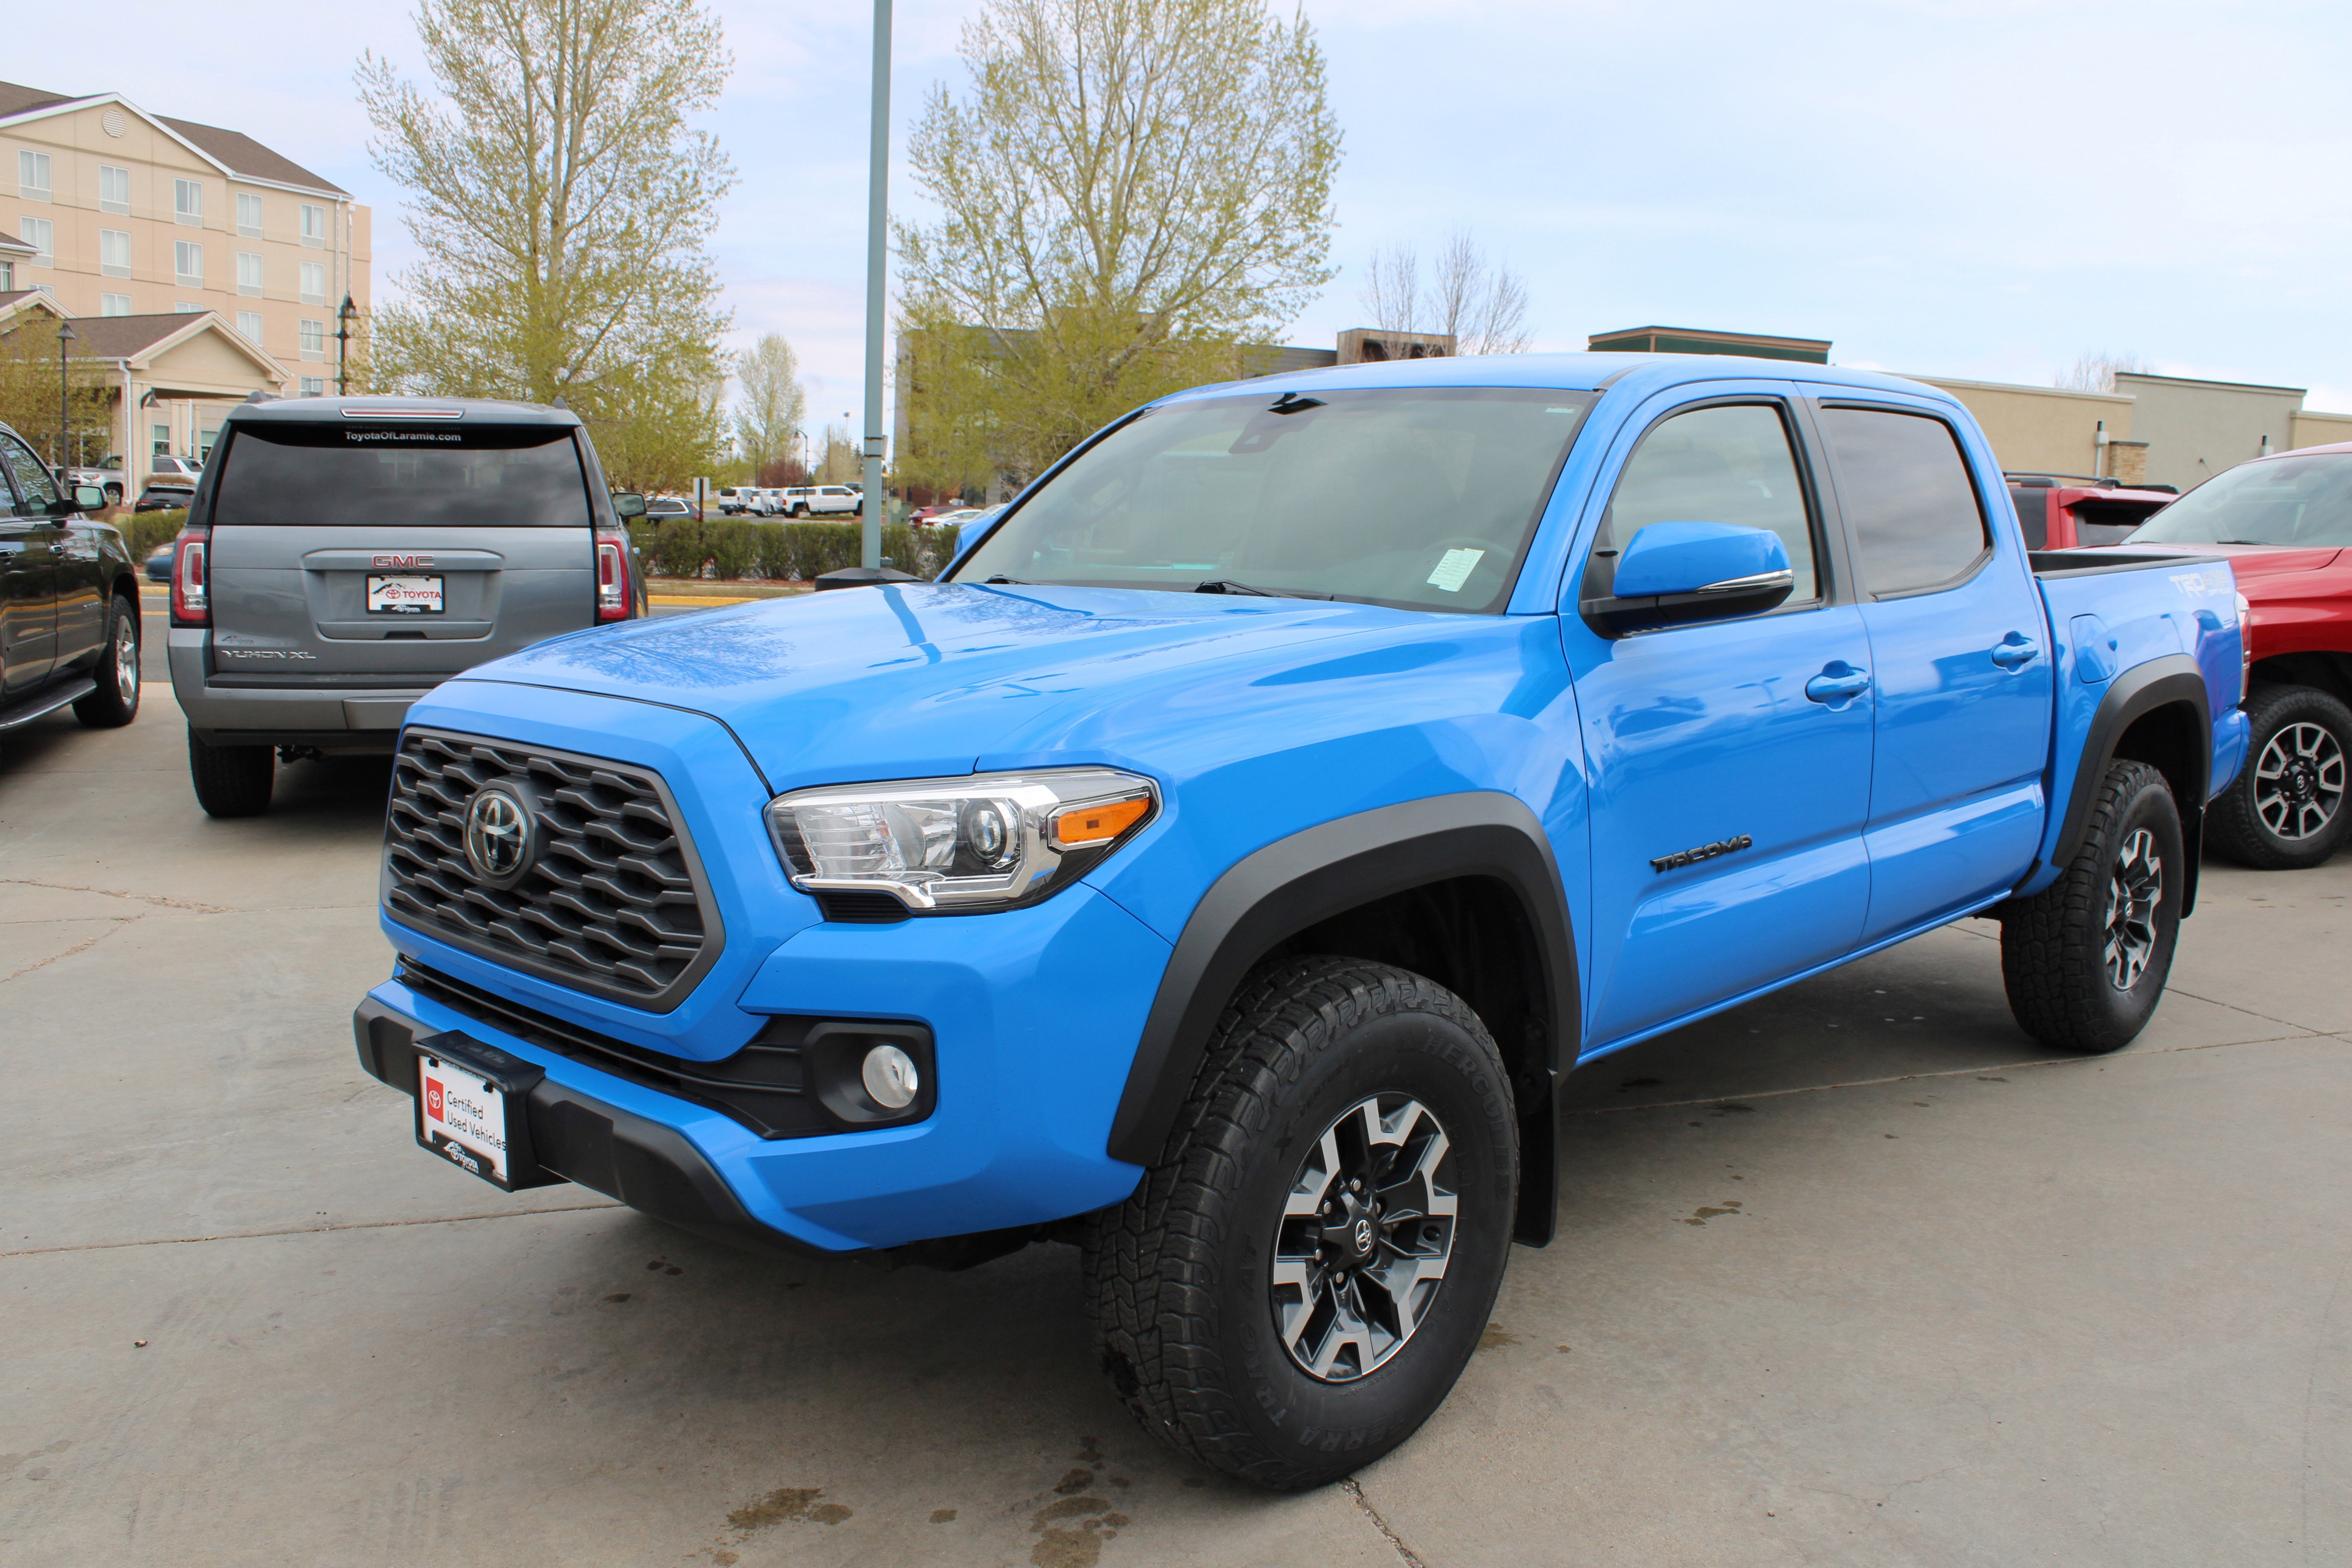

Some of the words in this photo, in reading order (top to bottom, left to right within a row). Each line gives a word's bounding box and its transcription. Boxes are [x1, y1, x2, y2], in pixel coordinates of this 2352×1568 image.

[345, 432, 461, 441] ToyotaOfLaramie.com
[372, 555, 435, 568] GMC
[2168, 572, 2205, 598] TRD
[221, 650, 287, 658] YUKON
[289, 651, 316, 659] XL
[1650, 834, 1753, 873] TACOMA
[448, 1091, 483, 1120] Certified
[1420, 1031, 1510, 1200] HERCULES
[448, 1110, 467, 1133] Used
[469, 1121, 506, 1151] Vehicles
[459, 1152, 479, 1169] TOYOTA
[1238, 1323, 1289, 1428] TRAC
[1295, 1405, 1406, 1452] TERRA
